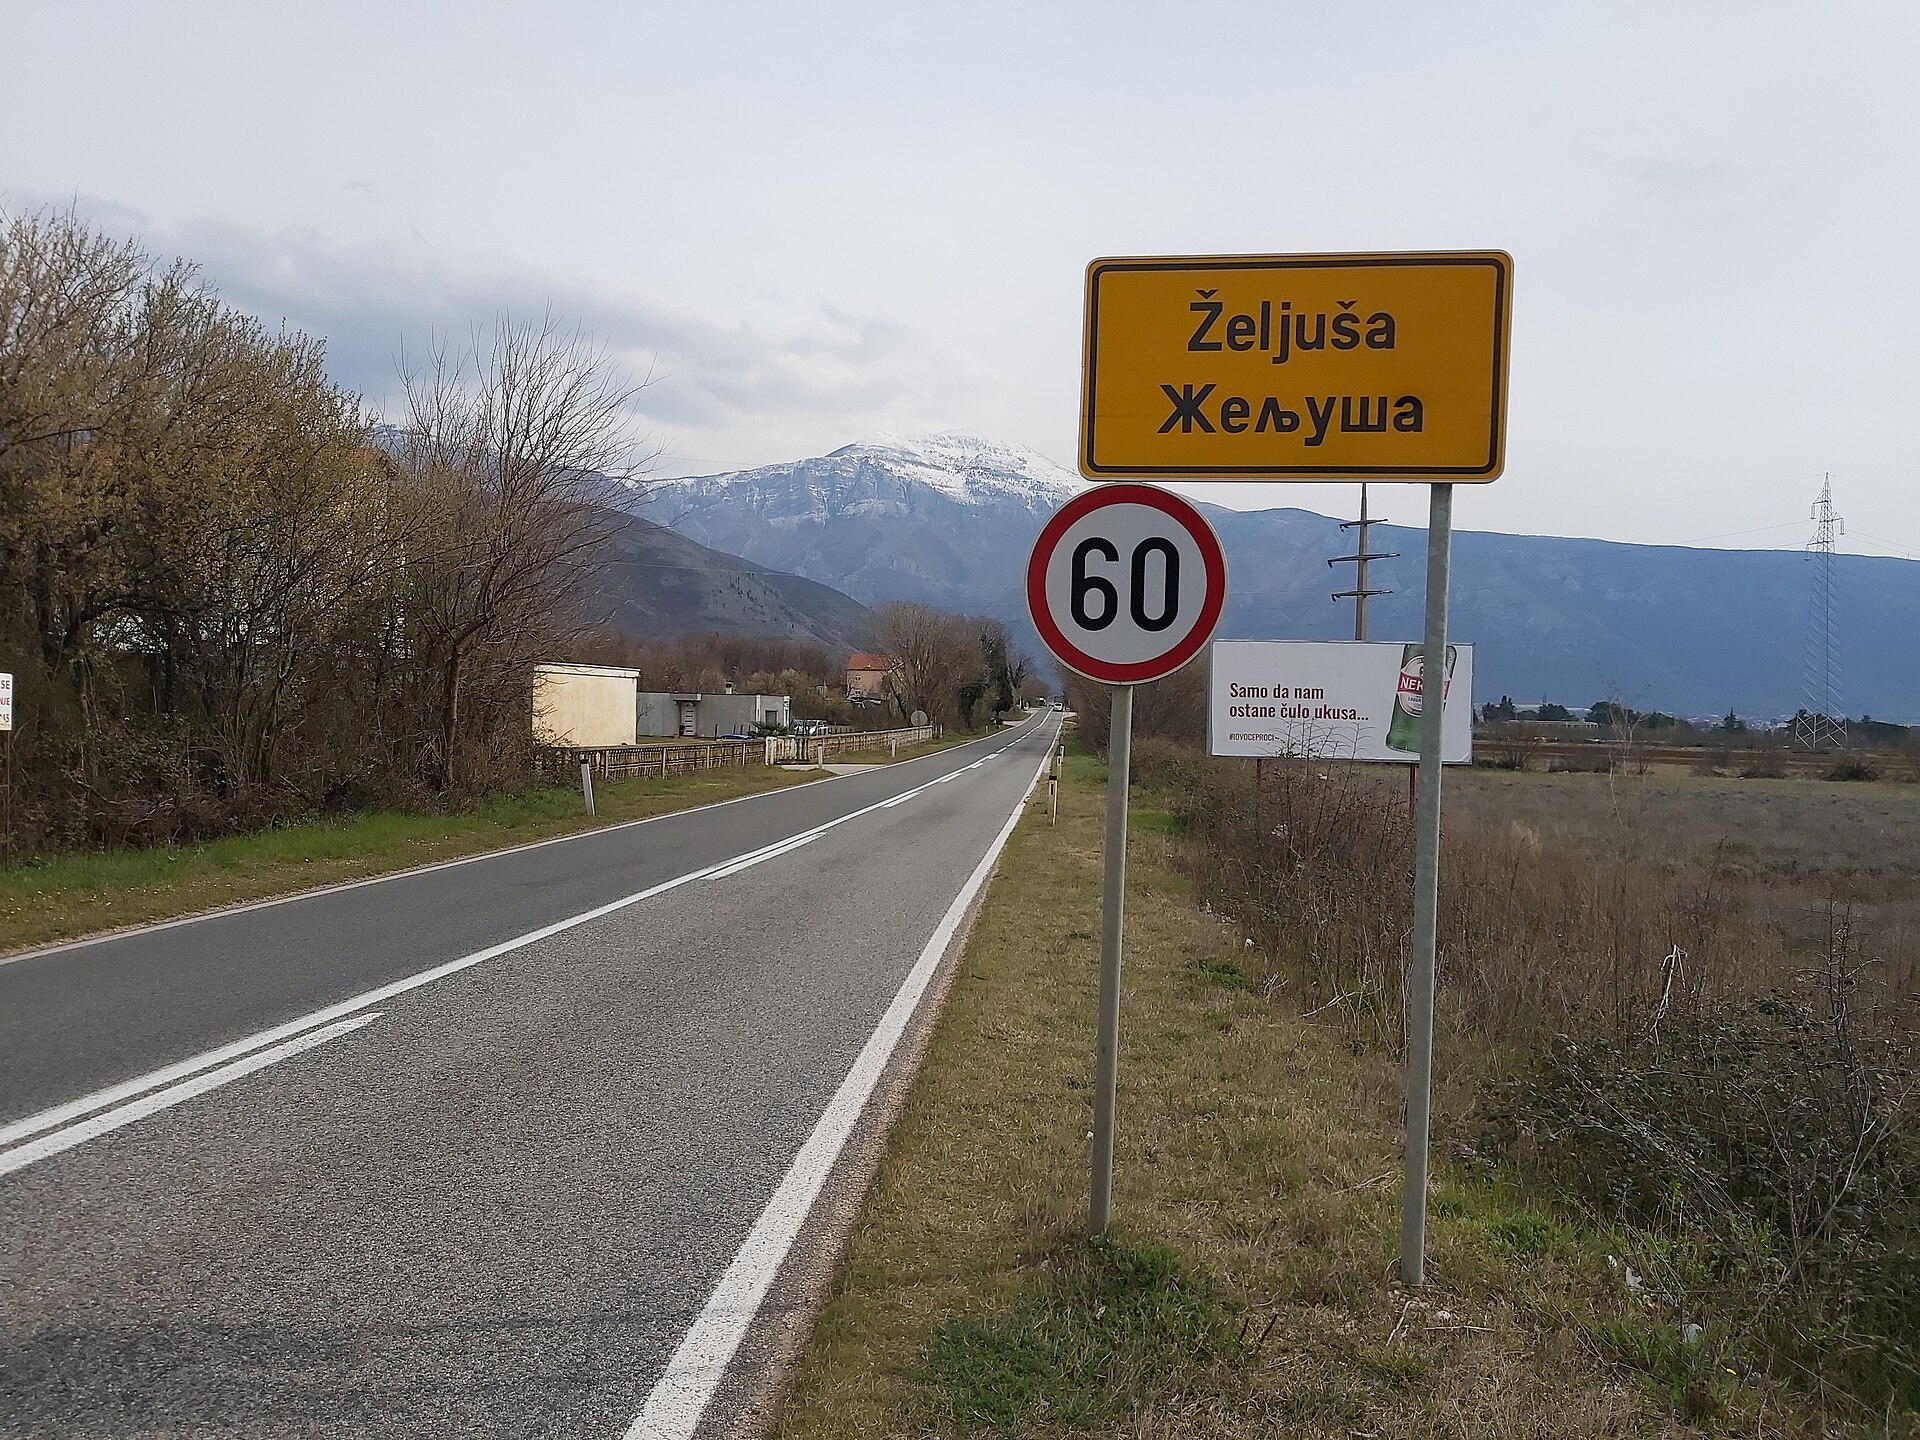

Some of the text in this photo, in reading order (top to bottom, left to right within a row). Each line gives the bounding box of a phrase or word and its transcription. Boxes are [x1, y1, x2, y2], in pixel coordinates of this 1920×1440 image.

[1187, 289, 1396, 364] Željuša
[1157, 383, 1424, 447] Жељуша
[1070, 536, 1181, 632] 60
[1229, 702, 1369, 721] ostane čulo ukusa...
[1230, 682, 1324, 700] Samo da nam
